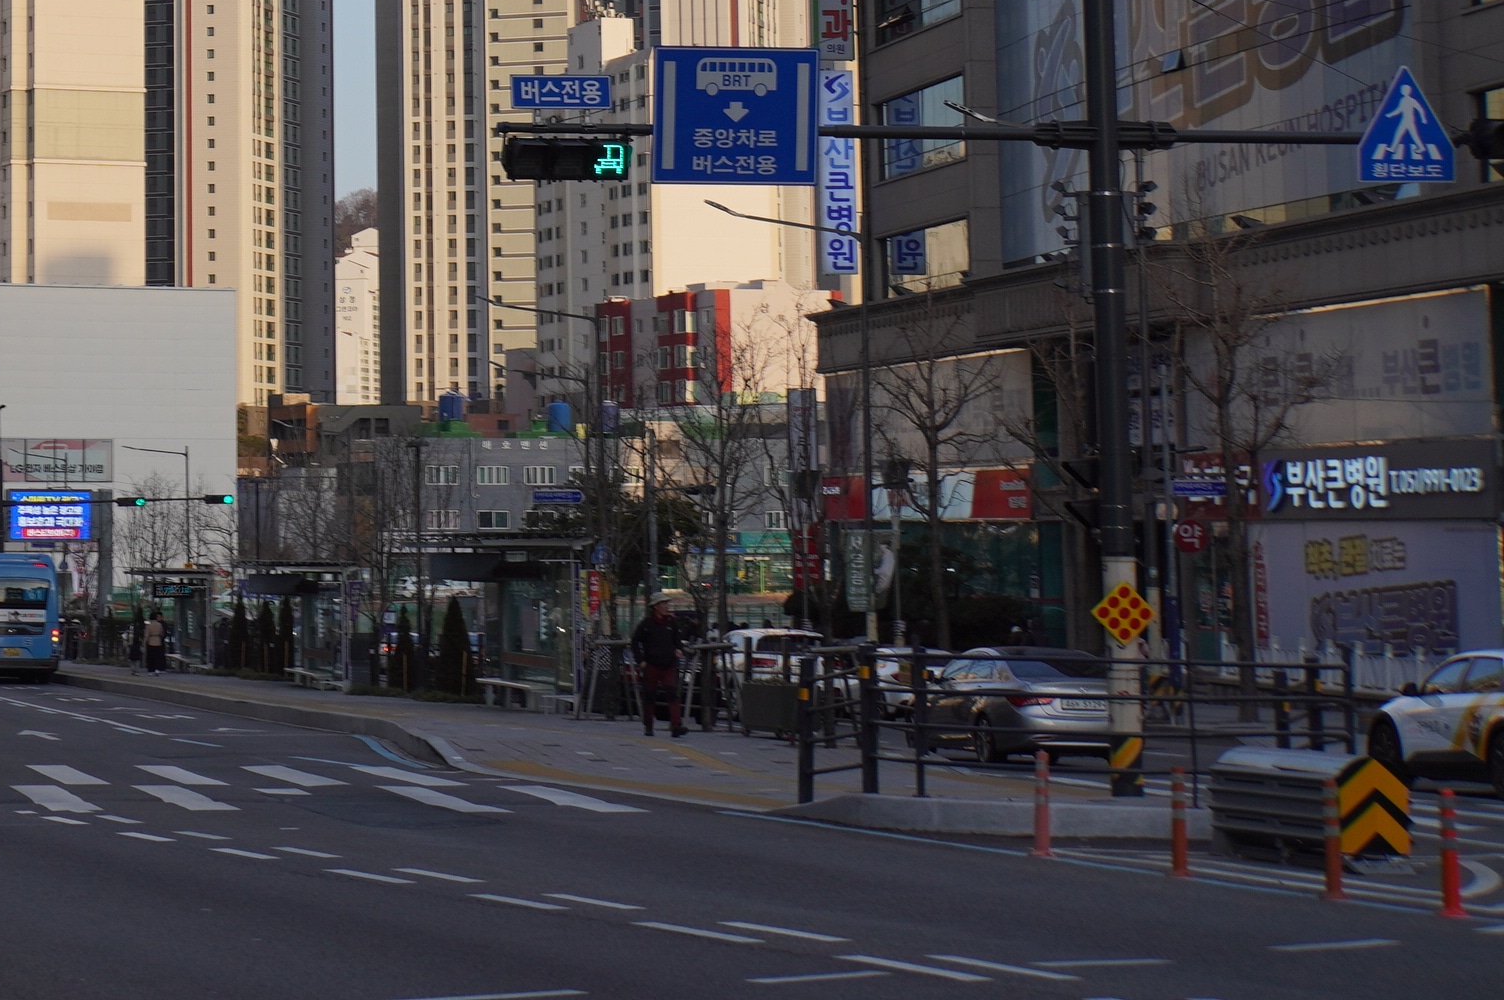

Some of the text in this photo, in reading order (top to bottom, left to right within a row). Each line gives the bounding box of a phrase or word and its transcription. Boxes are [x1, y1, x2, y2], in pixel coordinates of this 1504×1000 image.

[520, 80, 603, 104] 버스전용
[722, 74, 752, 88] BRT
[693, 127, 778, 149] 중앙차로
[693, 155, 778, 175] 버스전용
[1371, 161, 1444, 178] 횡단보도
[1286, 455, 1390, 509] 부산큰병원
[1178, 524, 1205, 550] 약
